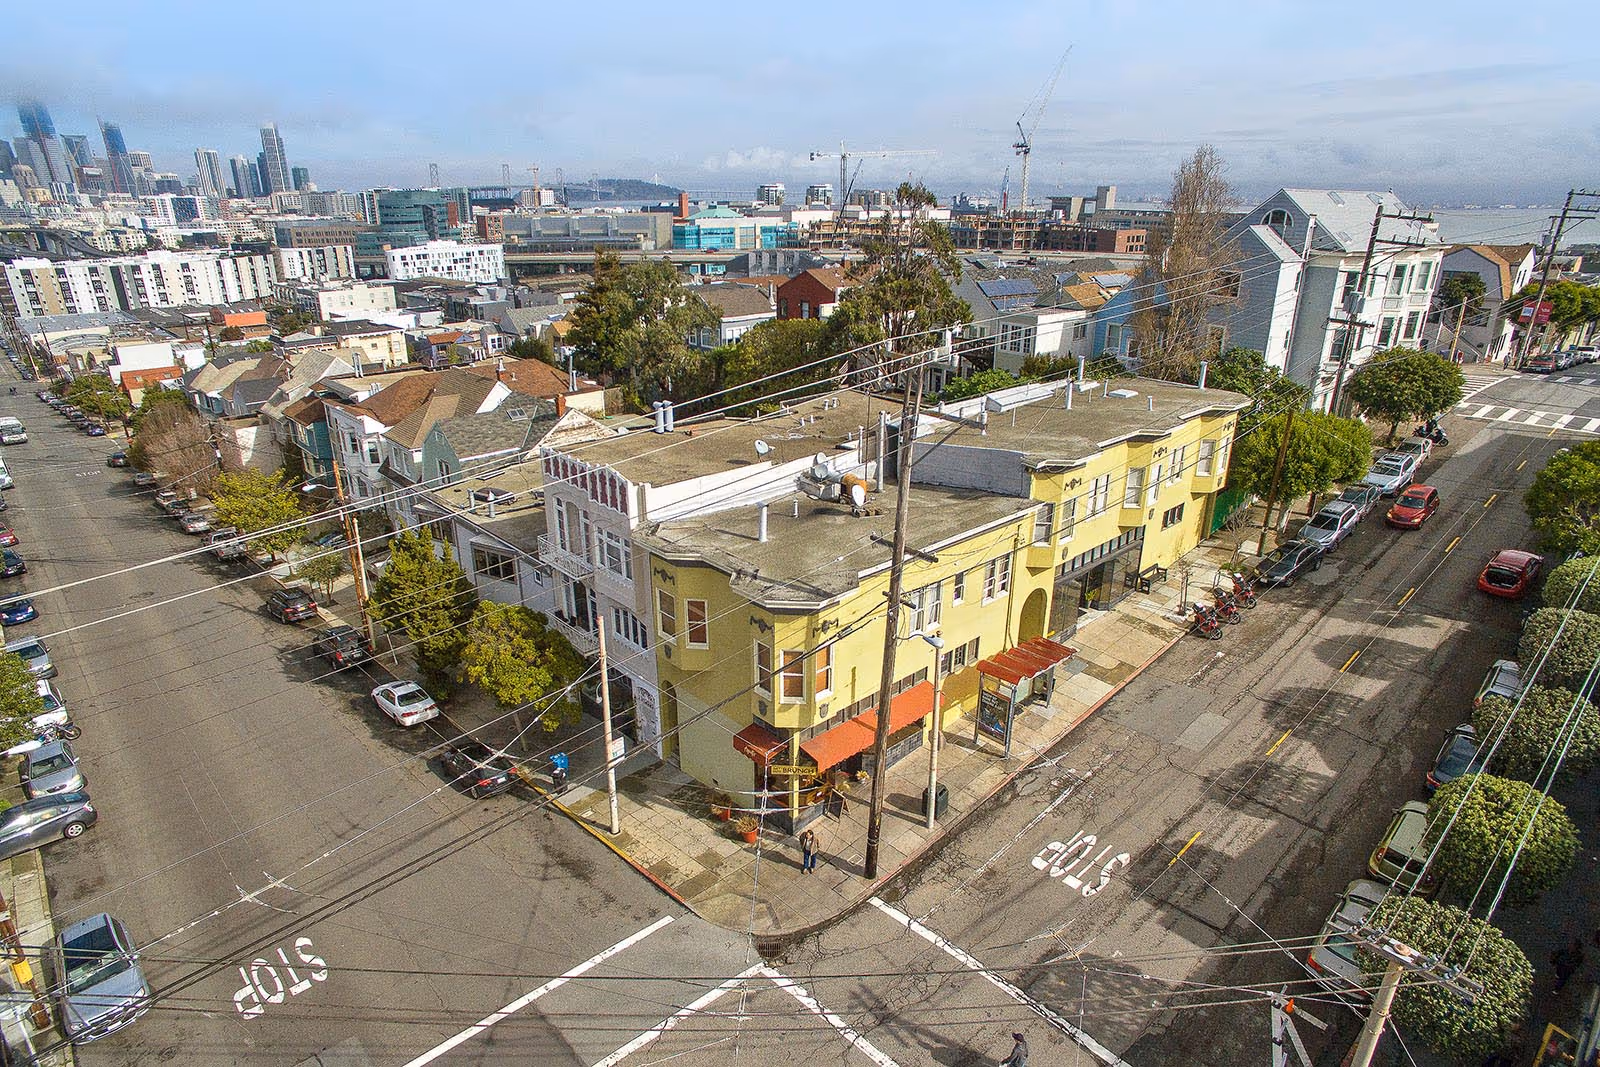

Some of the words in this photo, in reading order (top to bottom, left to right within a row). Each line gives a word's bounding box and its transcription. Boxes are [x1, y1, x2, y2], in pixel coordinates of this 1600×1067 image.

[782, 766, 815, 774] BRUNCH
[1031, 830, 1131, 897] STOP
[233, 937, 328, 1020] STOP
